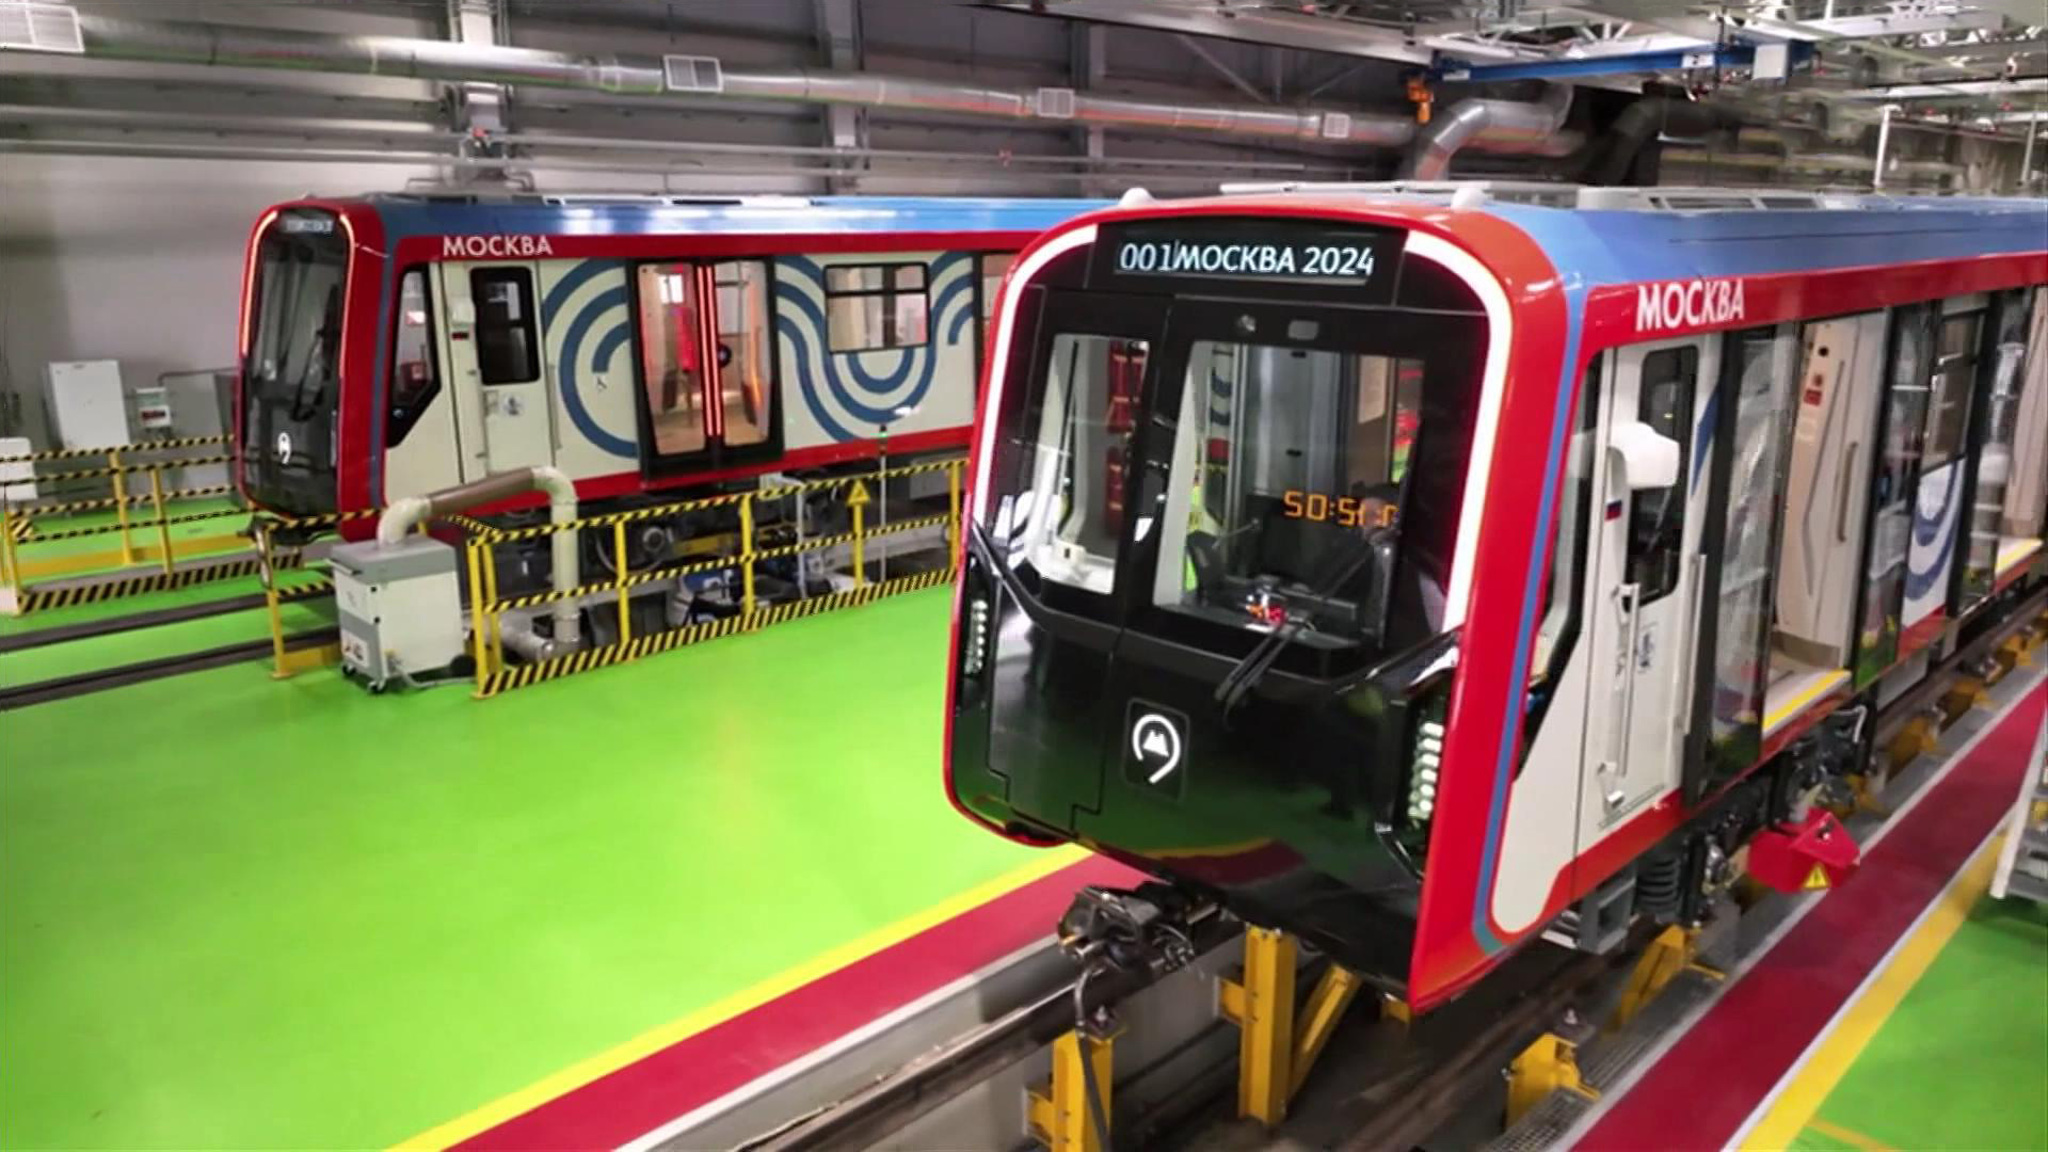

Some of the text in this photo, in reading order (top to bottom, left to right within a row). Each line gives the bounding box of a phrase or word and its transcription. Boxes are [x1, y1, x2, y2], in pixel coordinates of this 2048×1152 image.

[443, 235, 553, 257] МОСКВА
[1119, 243, 1374, 276] 001 МОСКВА 2024
[1635, 278, 1745, 332] МОСКВА
